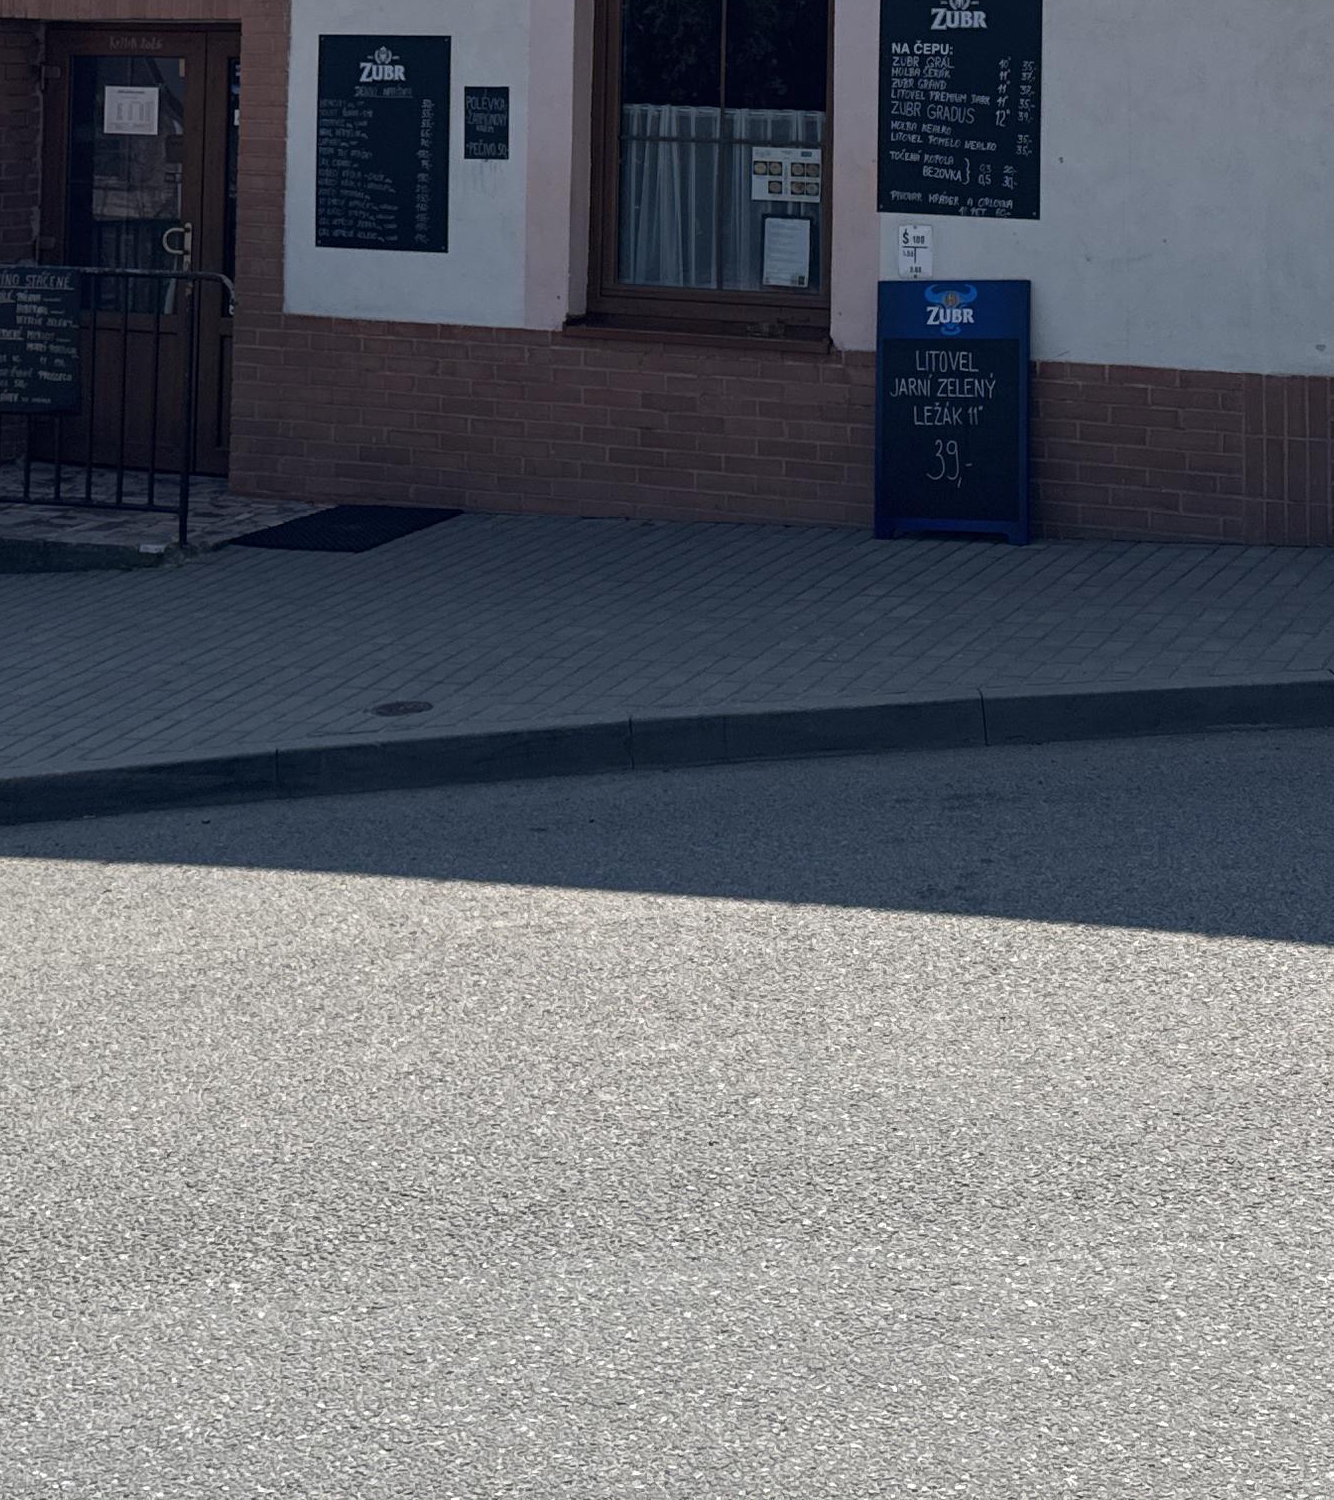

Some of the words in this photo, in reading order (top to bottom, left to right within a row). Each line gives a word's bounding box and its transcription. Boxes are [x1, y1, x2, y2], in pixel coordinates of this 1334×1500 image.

[930, 8, 988, 30] ZUBR
[892, 43, 910, 54] NA
[914, 40, 953, 55] ČEPU:
[359, 62, 406, 82] ZUBR
[892, 56, 919, 67] ZUBR
[891, 89, 925, 100] LITOVEL
[891, 101, 921, 117] ZUBR
[927, 103, 975, 125] GRADUS
[922, 166, 962, 182] BEZOVKA
[926, 306, 975, 325] ZUBR
[916, 350, 979, 372] LITOVEL
[890, 373, 933, 397] JARNÍ
[937, 373, 995, 399] ZELENÝ
[913, 402, 963, 426] LEŽÁK
[926, 439, 973, 488] 39,-
